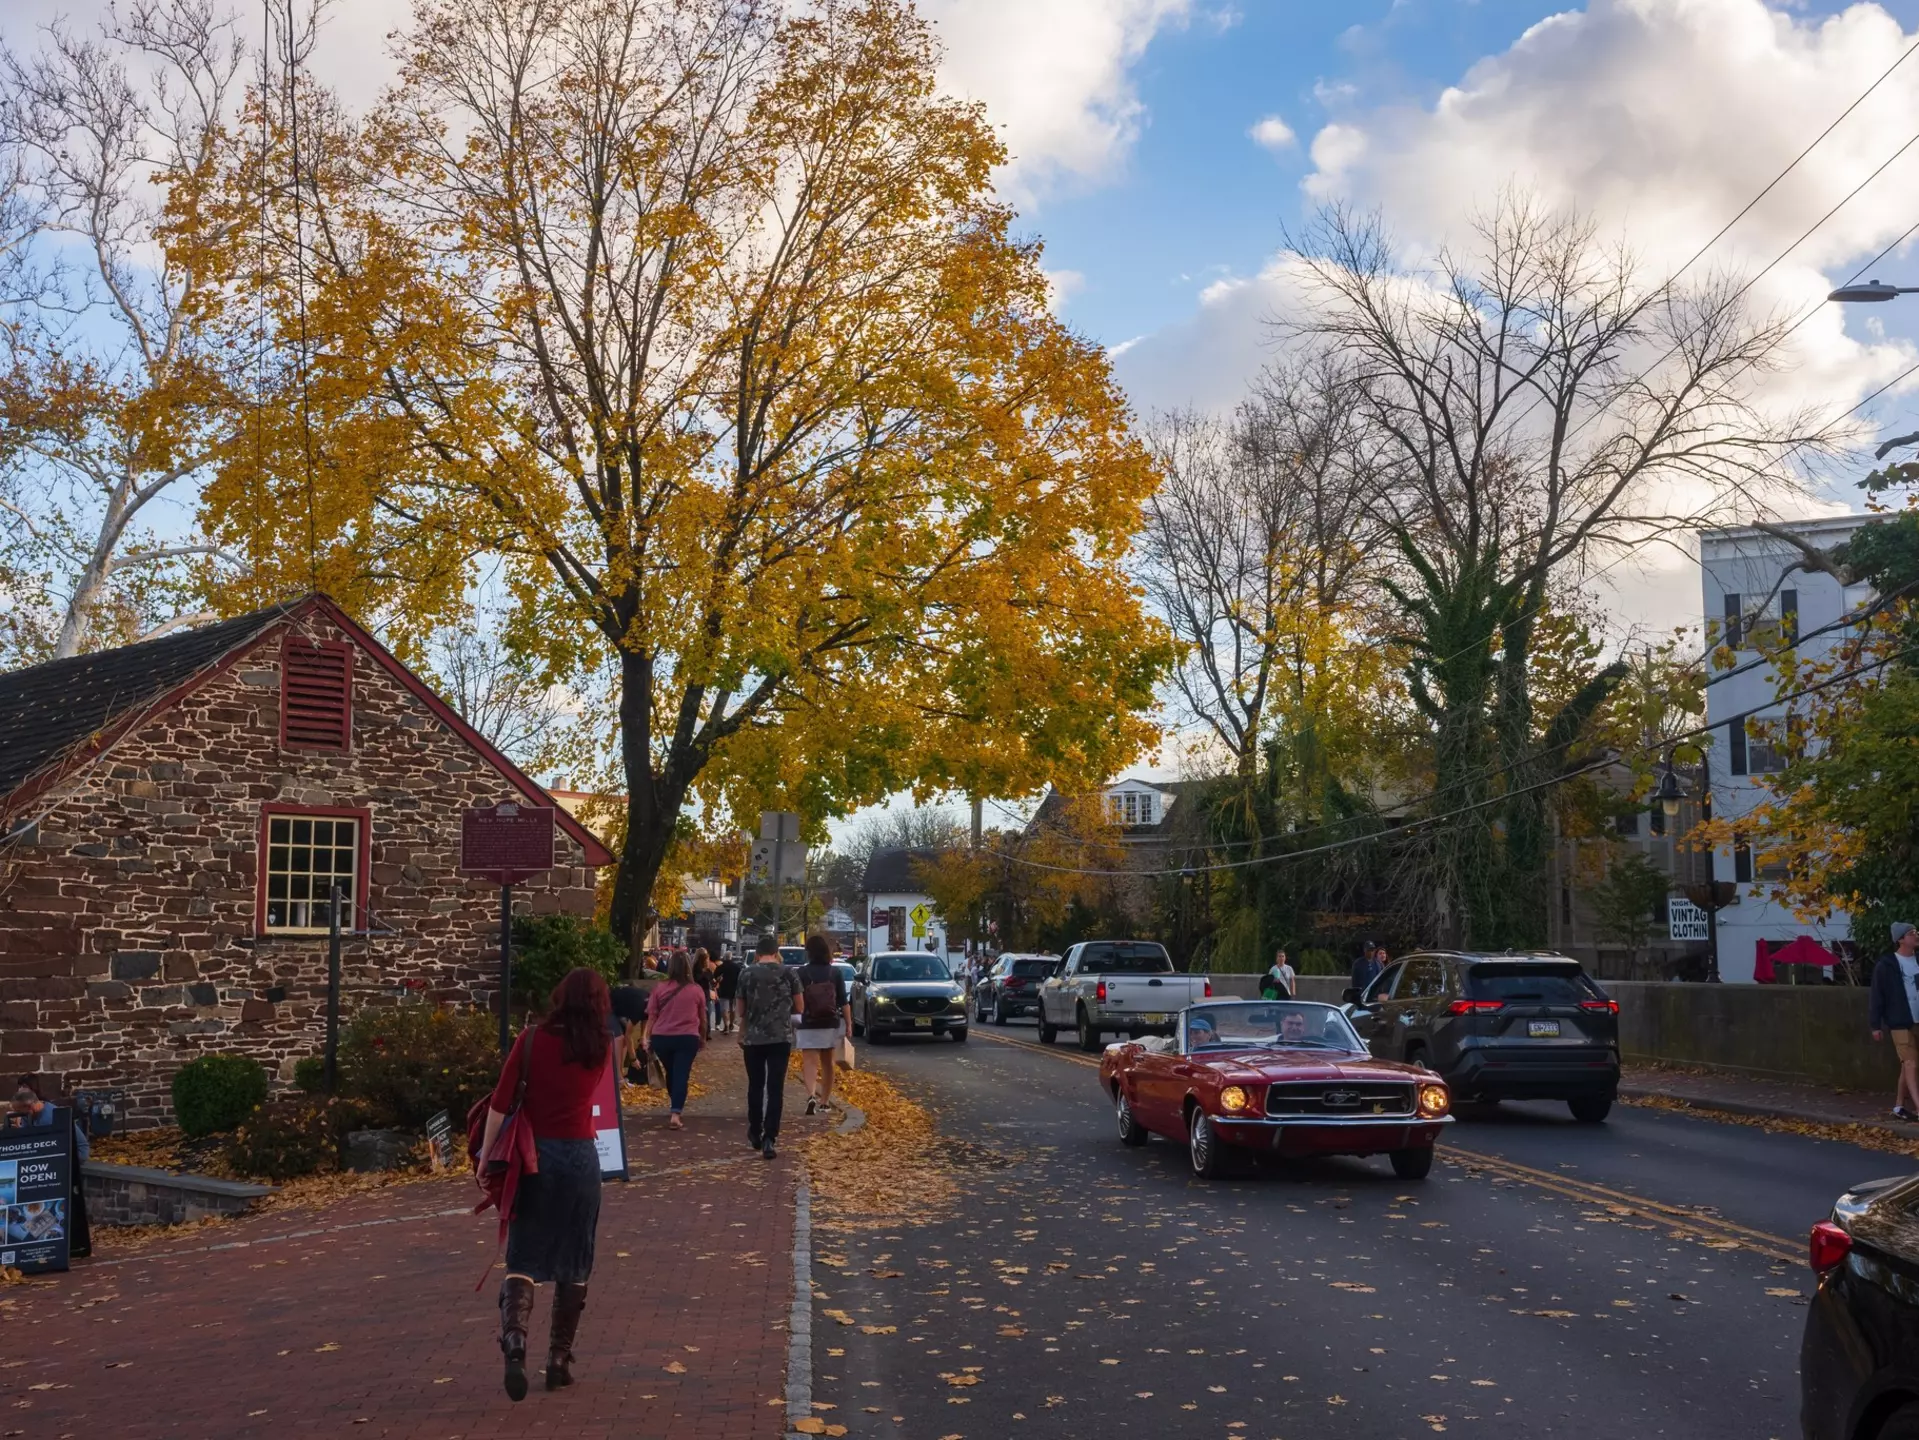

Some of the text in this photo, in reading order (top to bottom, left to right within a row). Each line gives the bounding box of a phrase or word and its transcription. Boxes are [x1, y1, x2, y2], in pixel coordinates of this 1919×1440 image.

[1671, 908, 1707, 922] VINTAG
[1672, 924, 1708, 938] CLOTHIN
[34, 1140, 57, 1149] DECK
[21, 1163, 49, 1174] NOW
[20, 1172, 57, 1183] OPEN!
